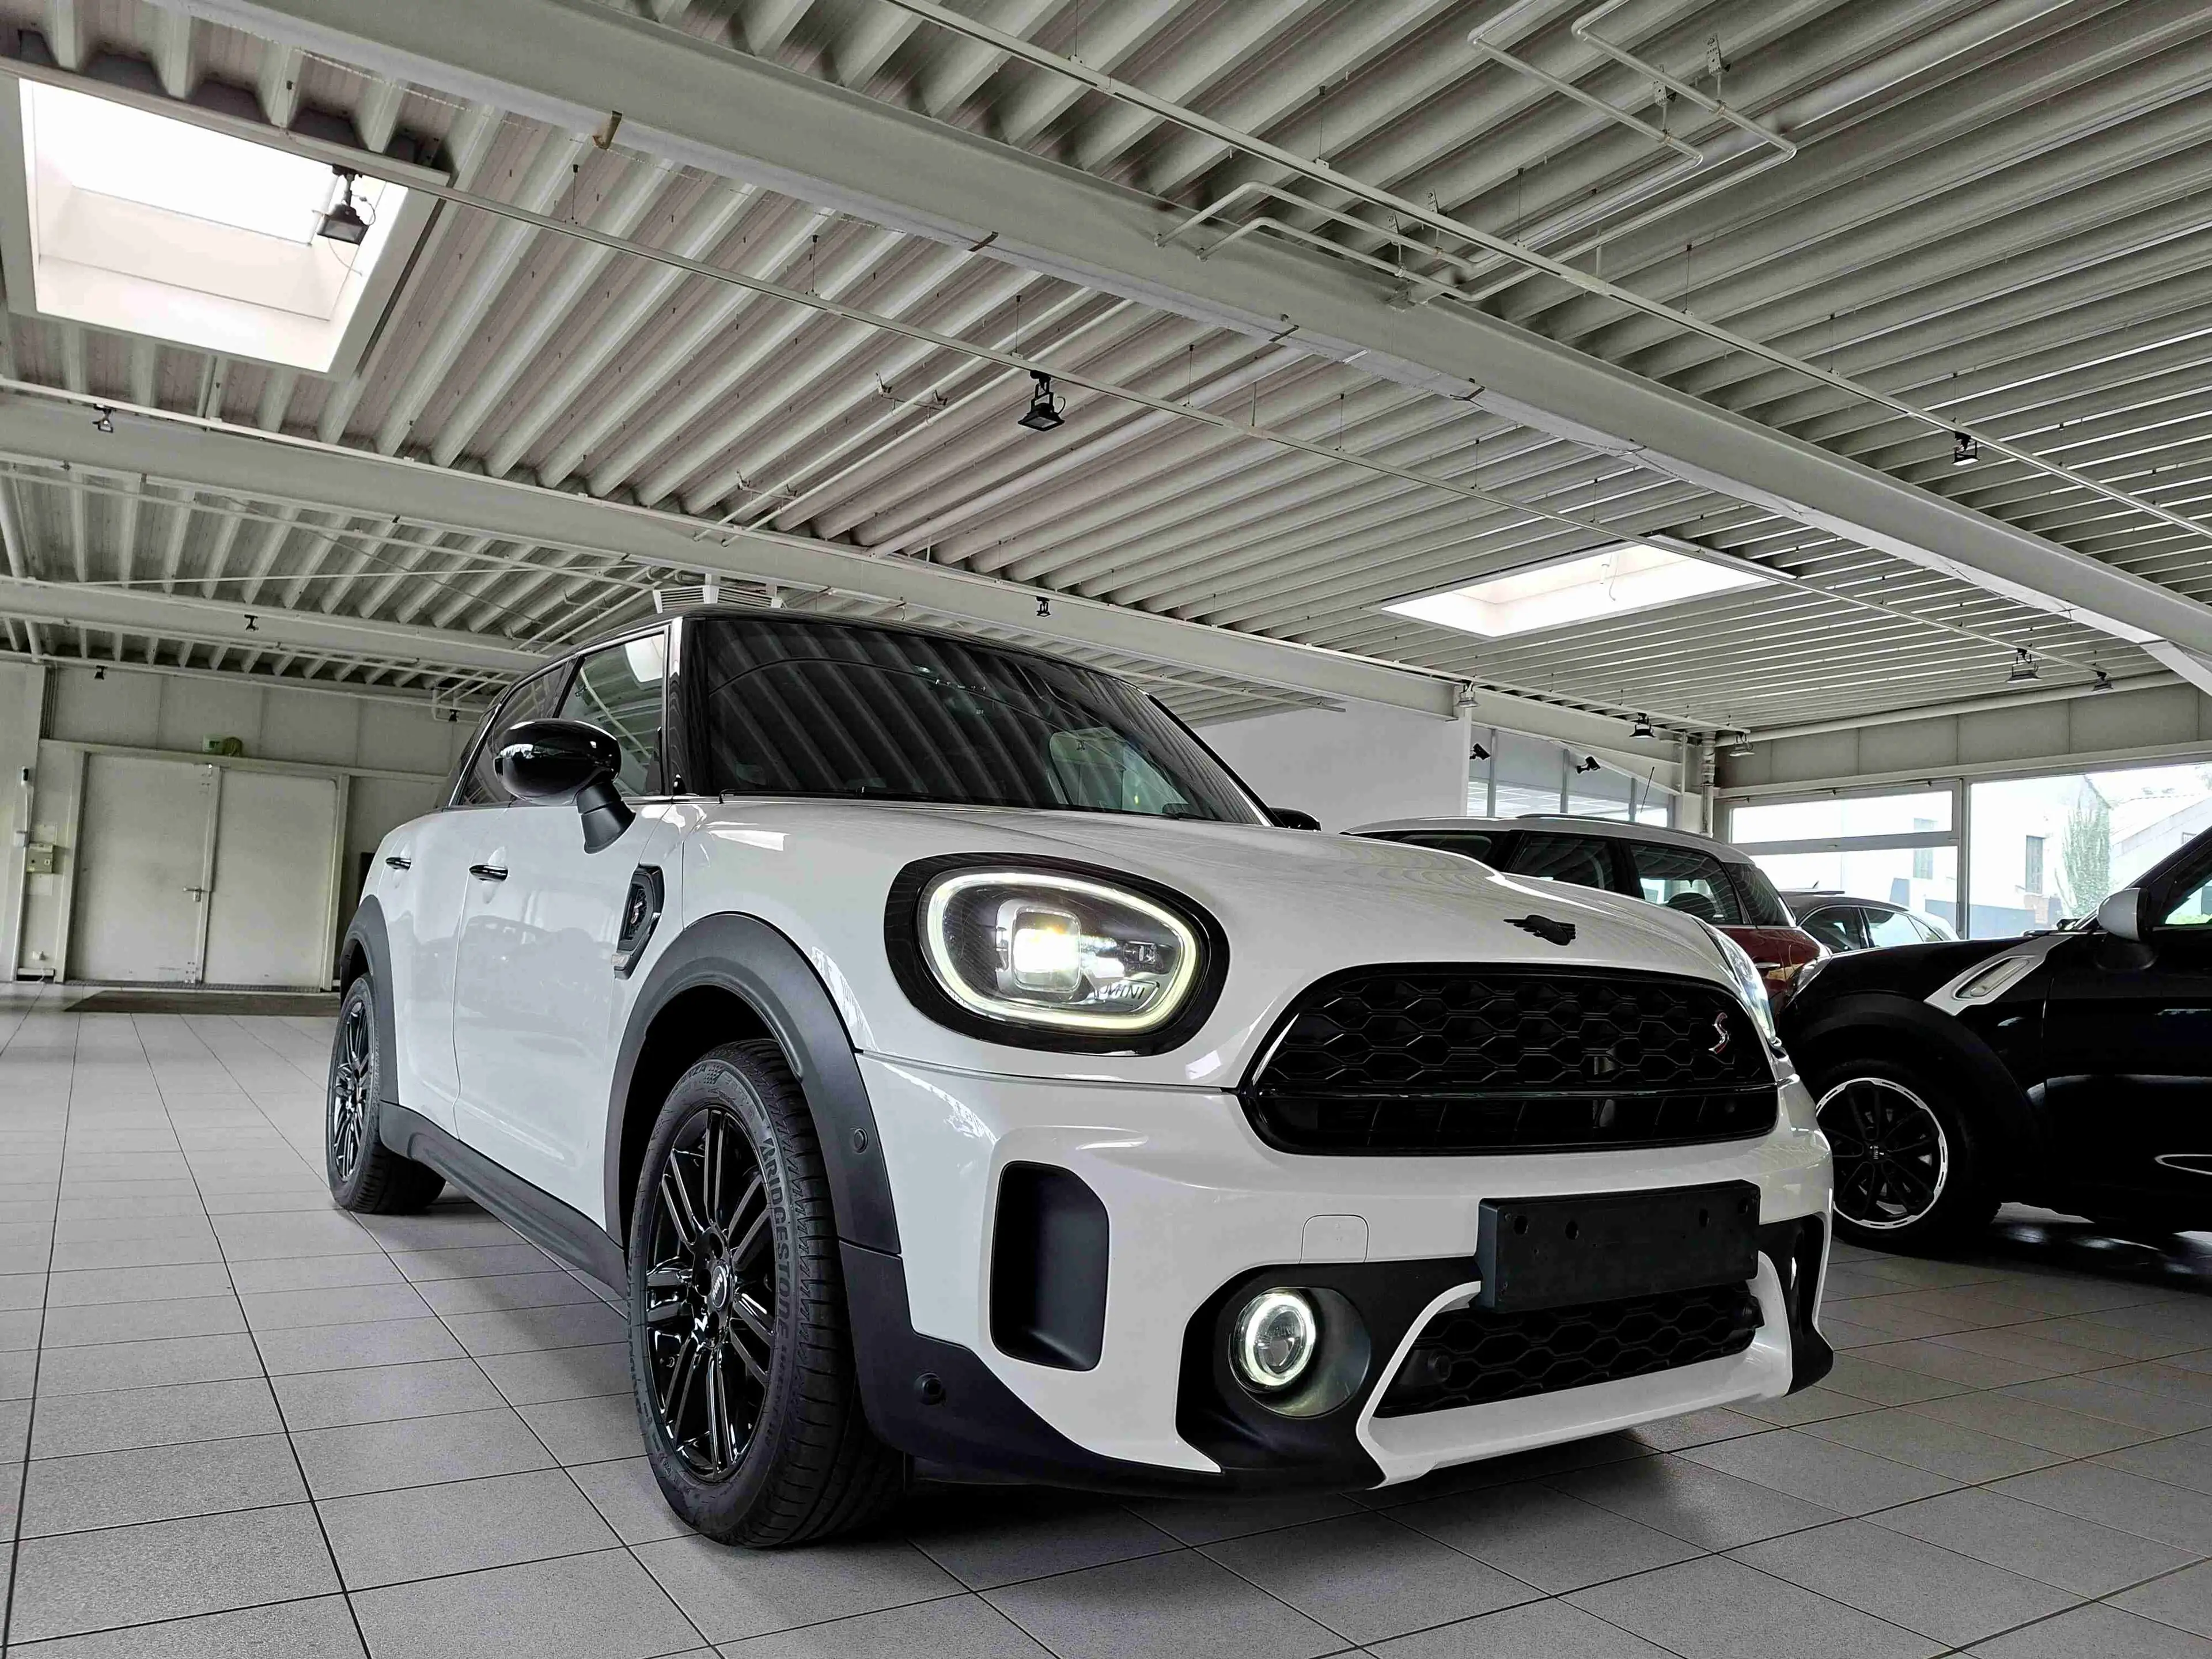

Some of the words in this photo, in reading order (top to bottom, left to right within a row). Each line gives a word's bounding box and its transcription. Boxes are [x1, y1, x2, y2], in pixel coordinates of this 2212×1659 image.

[1104, 983, 1145, 999] MINI
[1709, 1012, 1729, 1054] S
[759, 1137, 790, 1339] BRIDGESTONE
